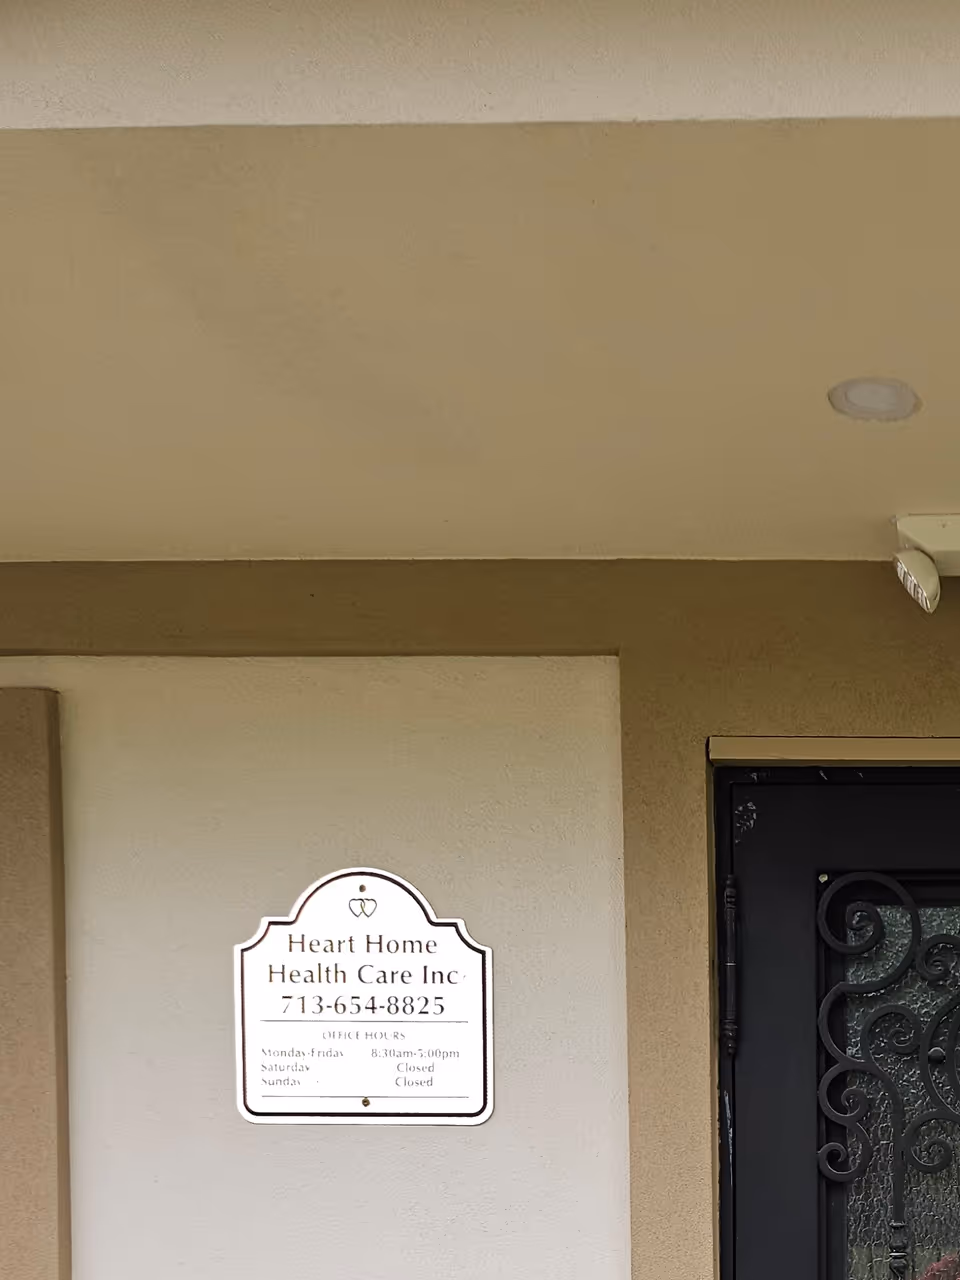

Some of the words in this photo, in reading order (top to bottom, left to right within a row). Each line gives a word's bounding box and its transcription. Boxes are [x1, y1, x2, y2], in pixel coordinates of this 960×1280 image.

[288, 934, 355, 953] Heart
[366, 934, 438, 954] Home
[268, 963, 347, 984] Health
[357, 964, 412, 985] Care
[281, 995, 445, 1016] 713-654-8825
[322, 1031, 360, 1040] OFFICE
[365, 1031, 406, 1040] HOURS
[261, 1047, 344, 1060] Monday-Friday
[370, 1048, 460, 1060] 8:30am-5:00pm
[261, 1061, 310, 1073] Saturday
[396, 1062, 435, 1073] Closed
[261, 1076, 301, 1088] Sunday
[395, 1076, 434, 1087] Closed
